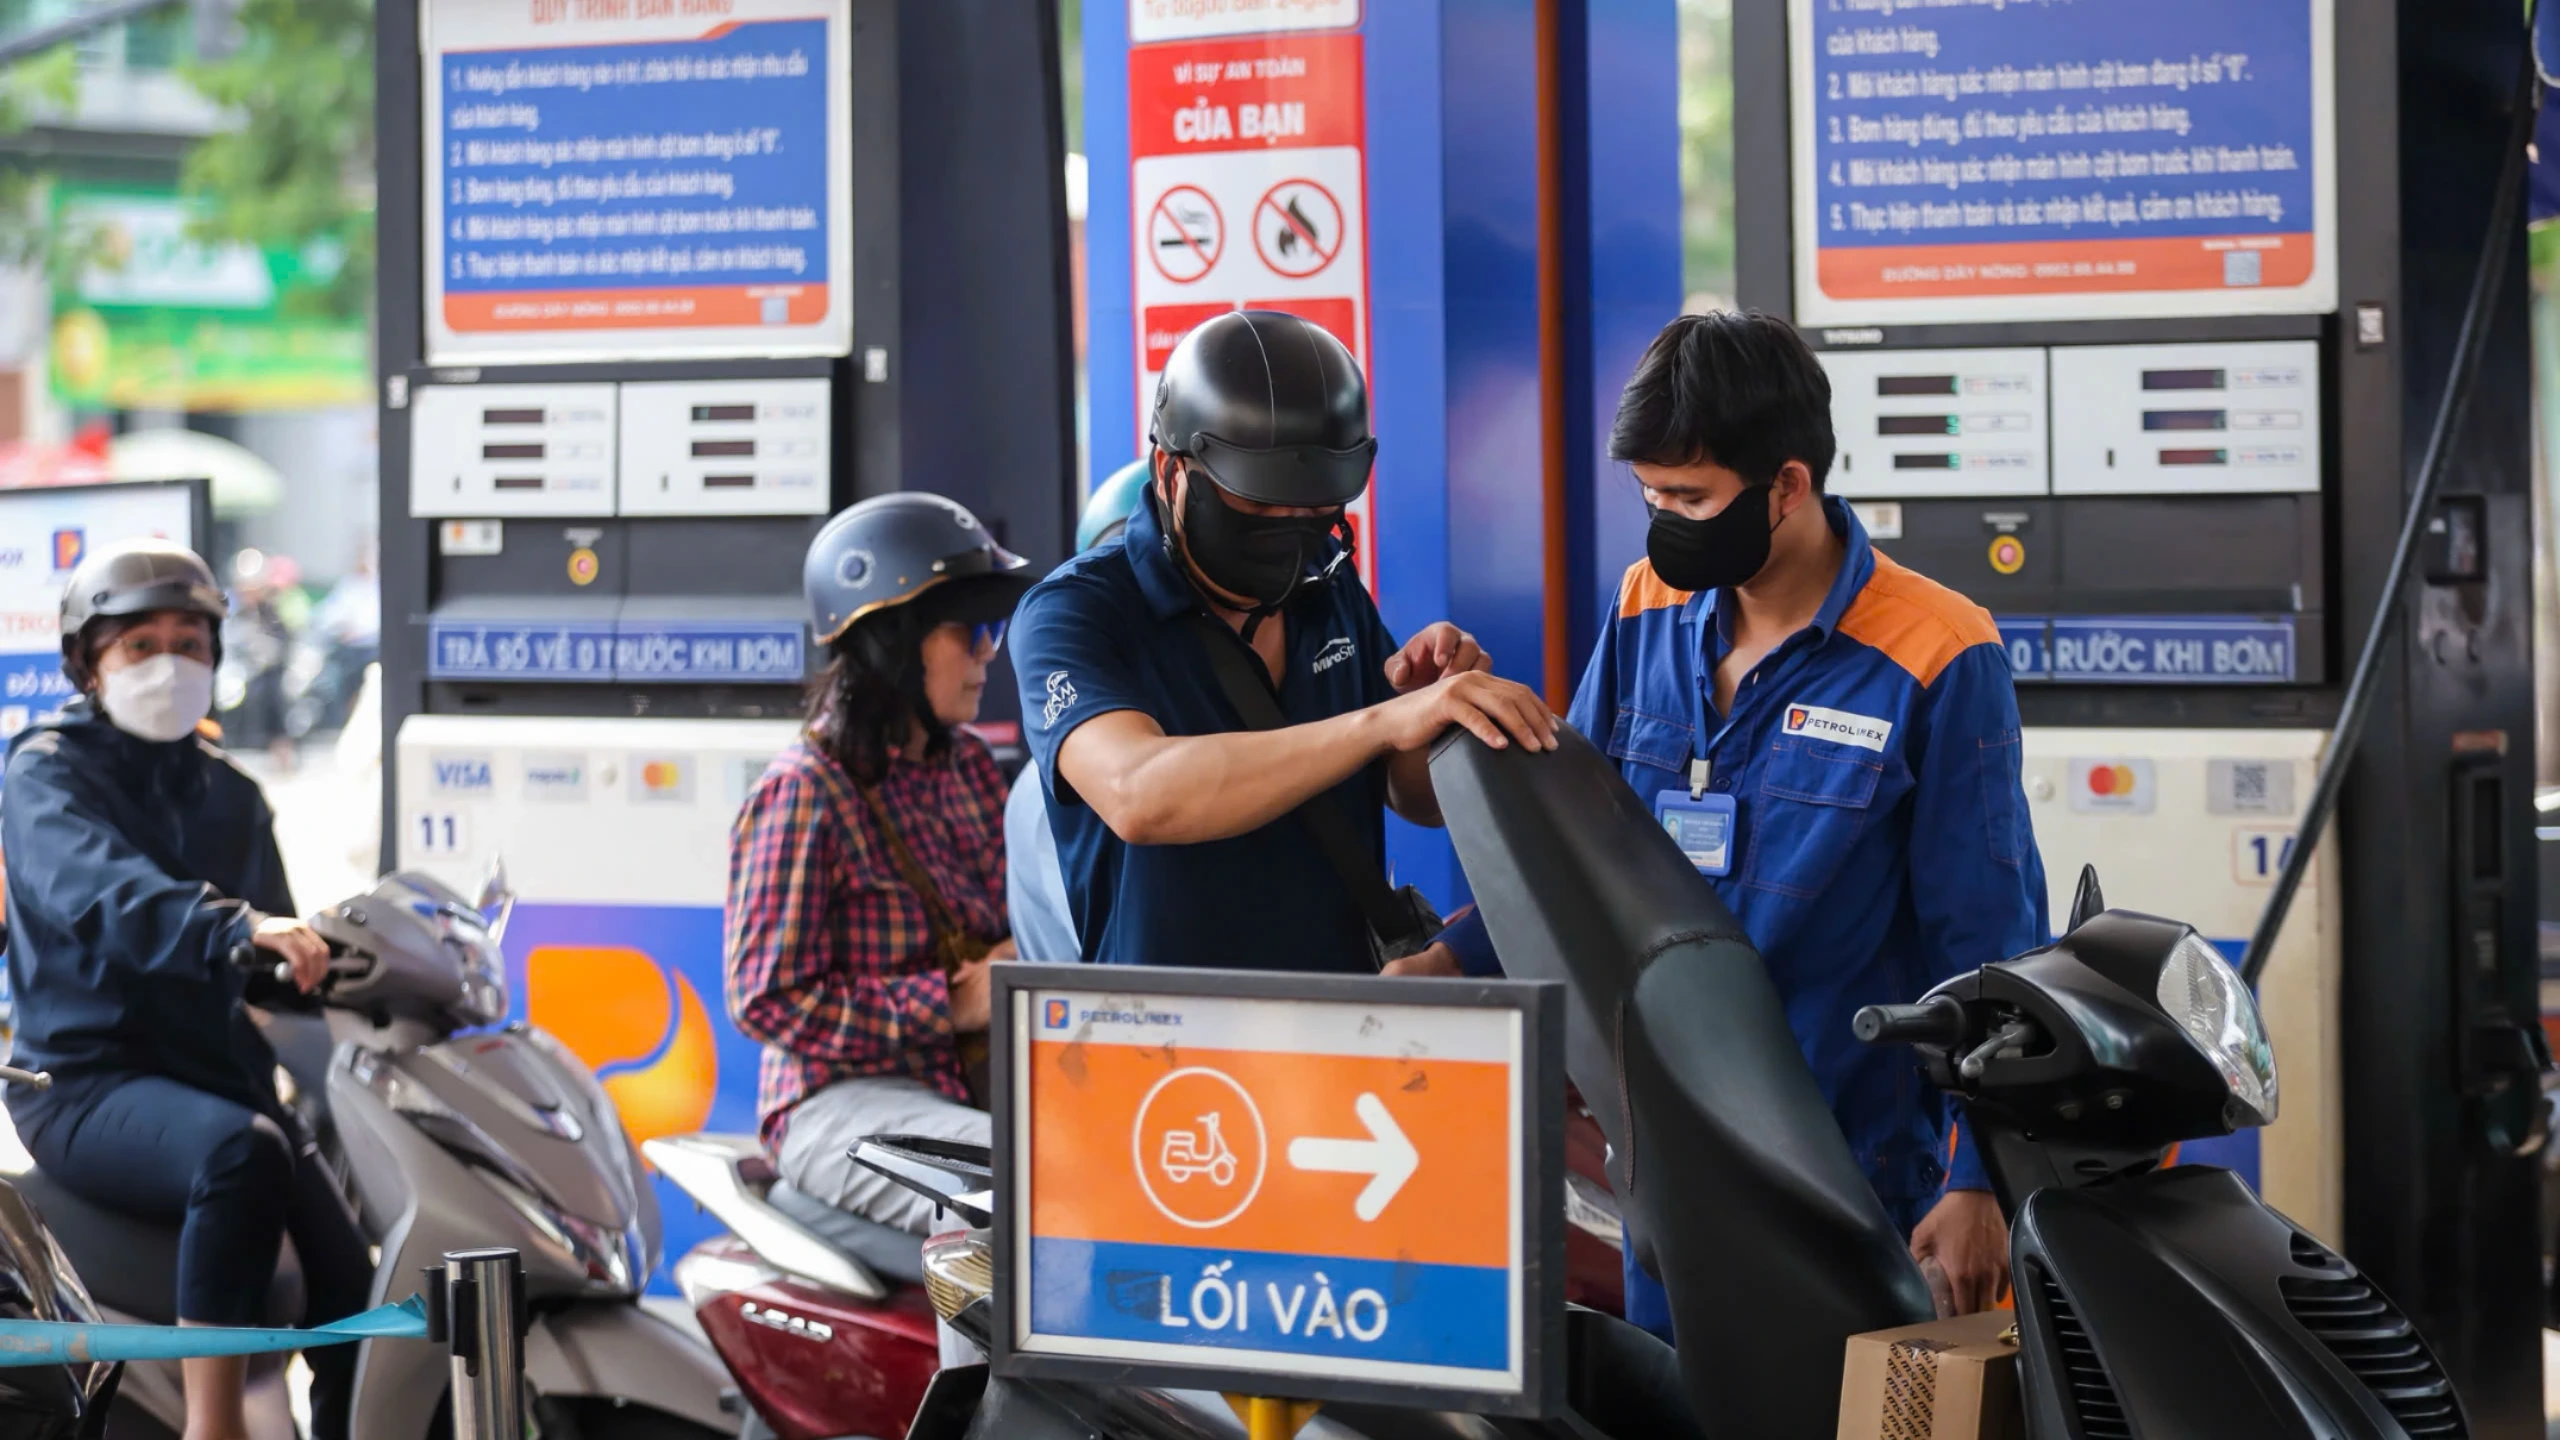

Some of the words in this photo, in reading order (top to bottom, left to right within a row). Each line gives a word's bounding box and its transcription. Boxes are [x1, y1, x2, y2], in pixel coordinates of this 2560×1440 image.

[1225, 62, 1251, 81] AN
[1256, 56, 1306, 78] TOÀN
[1174, 96, 1232, 143] CỦA
[1239, 102, 1305, 145] BẠN
[443, 627, 489, 671] TRẢ
[495, 627, 531, 671] SỐ
[534, 627, 571, 671] VỀ
[577, 637, 595, 672] 0
[600, 632, 687, 672] TRƯỚC
[691, 638, 733, 672] KHI
[738, 635, 795, 672] BƠM
[2011, 638, 2032, 672] 0
[2153, 639, 2204, 672] KHI
[2212, 635, 2284, 672] BƠM
[1807, 718, 1884, 741] PETROLIMEX
[435, 761, 493, 788] VISA
[421, 816, 456, 849] 11
[1080, 1009, 1184, 1026] PETROLIMEX
[1159, 1258, 1248, 1332] LỐI
[1266, 1271, 1389, 1342] VÀO
